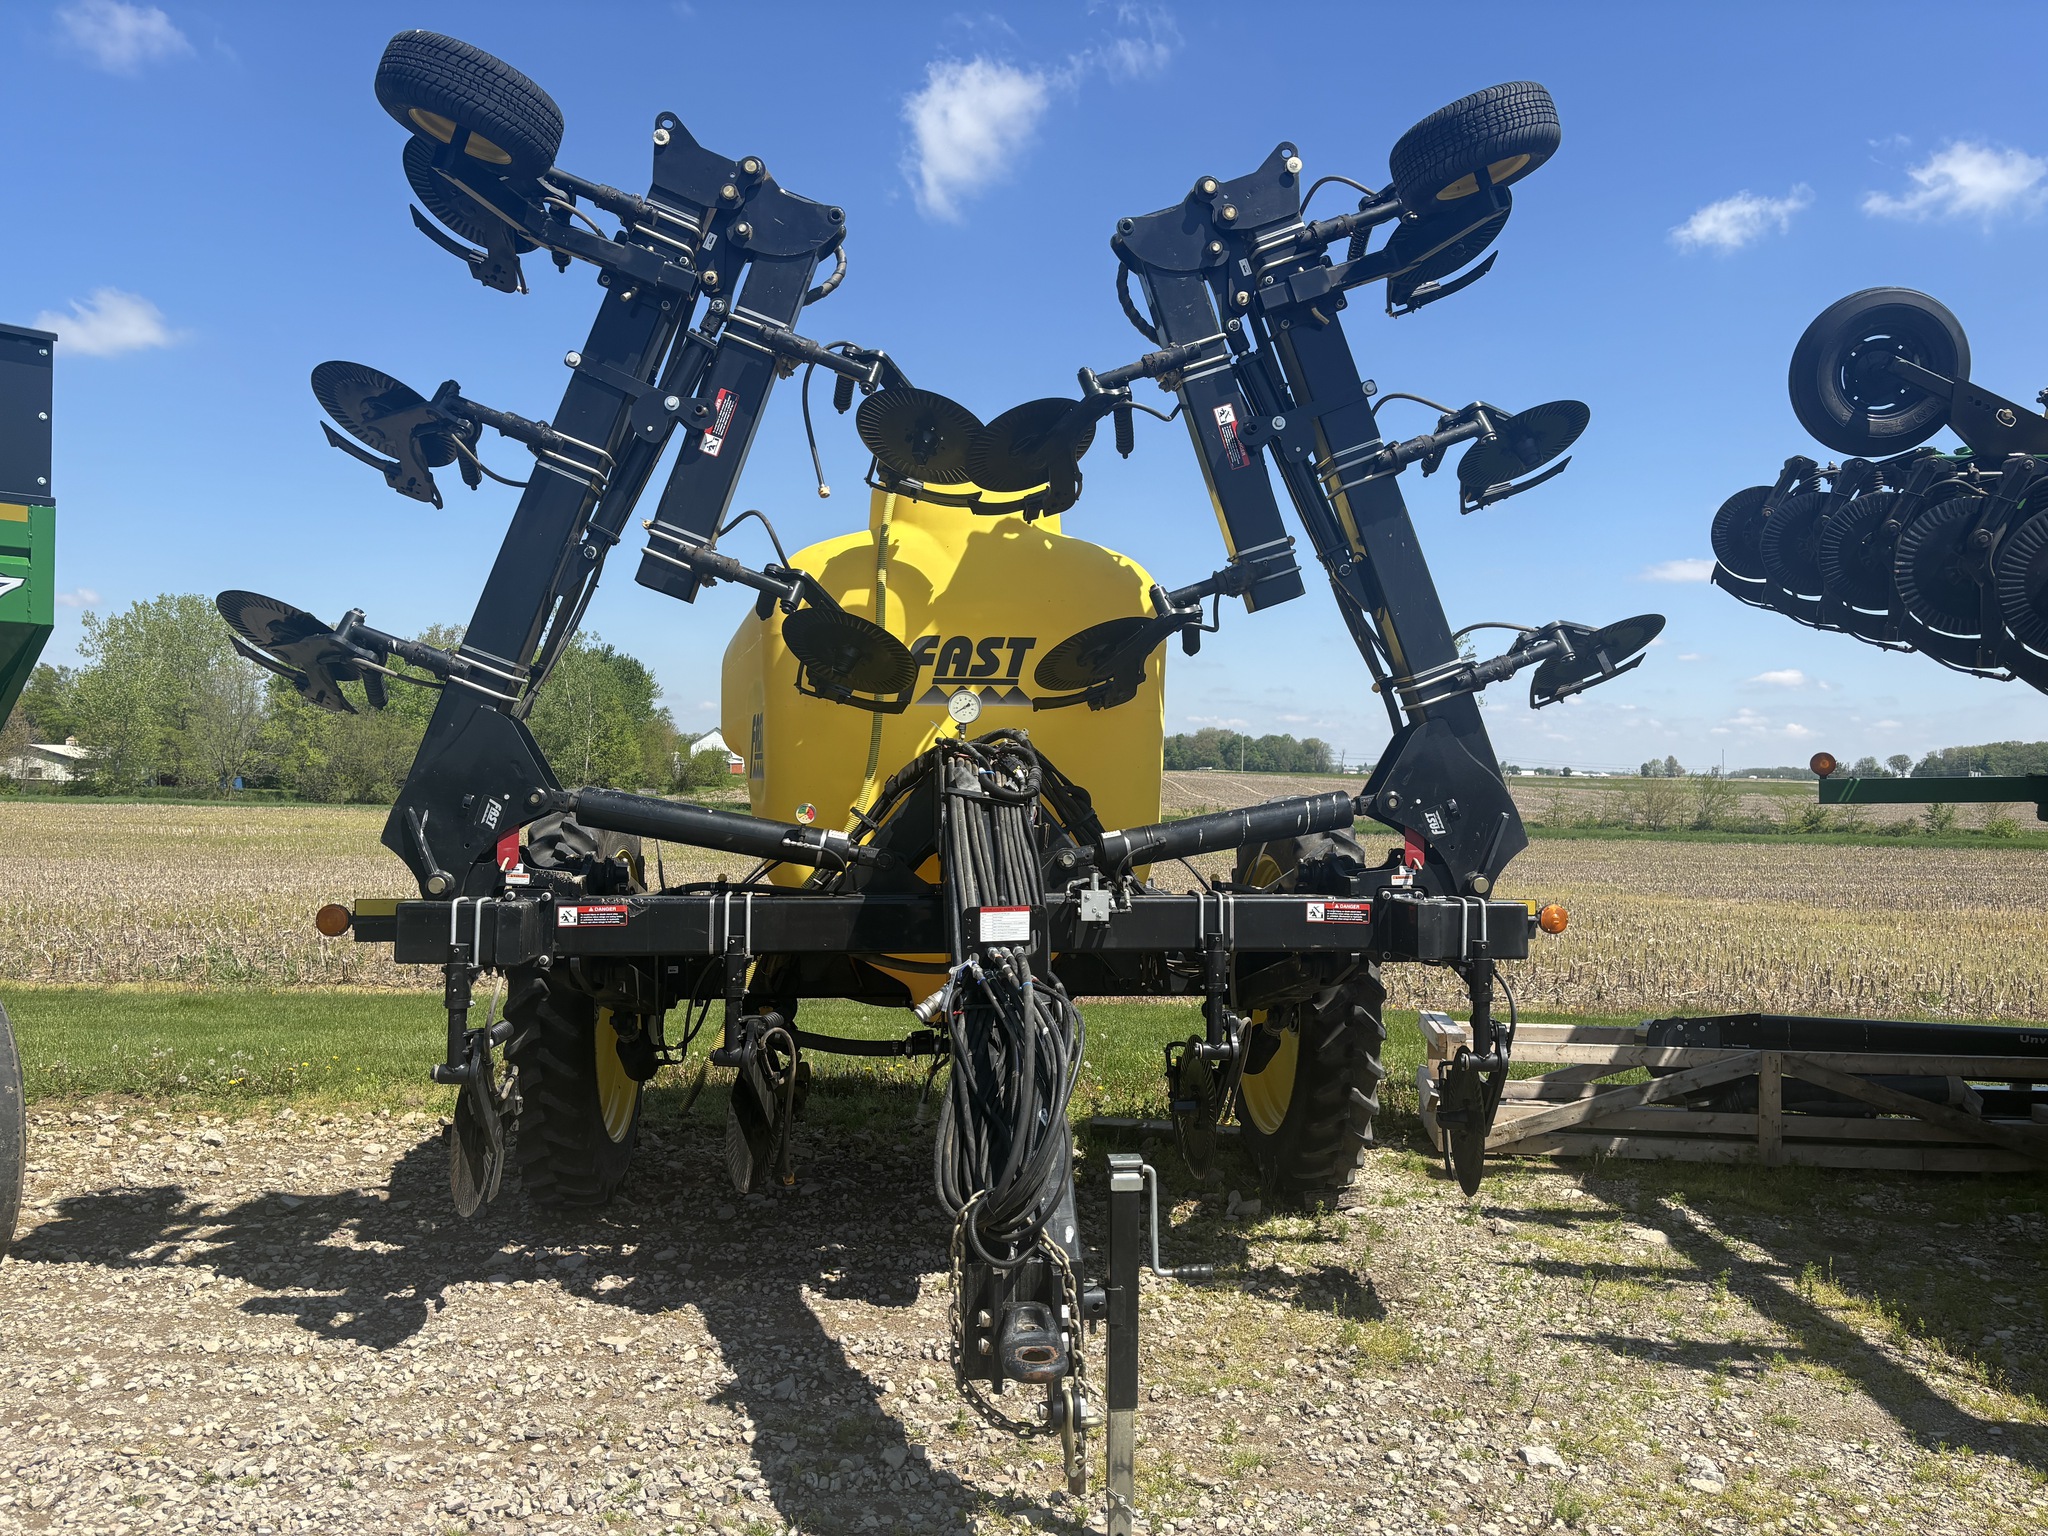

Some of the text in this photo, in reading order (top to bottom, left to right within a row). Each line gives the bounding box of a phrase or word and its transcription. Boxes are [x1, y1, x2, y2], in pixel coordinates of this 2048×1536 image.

[909, 635, 1037, 682] FAST
[485, 799, 502, 830] FAST
[1424, 812, 1446, 835] FAST
